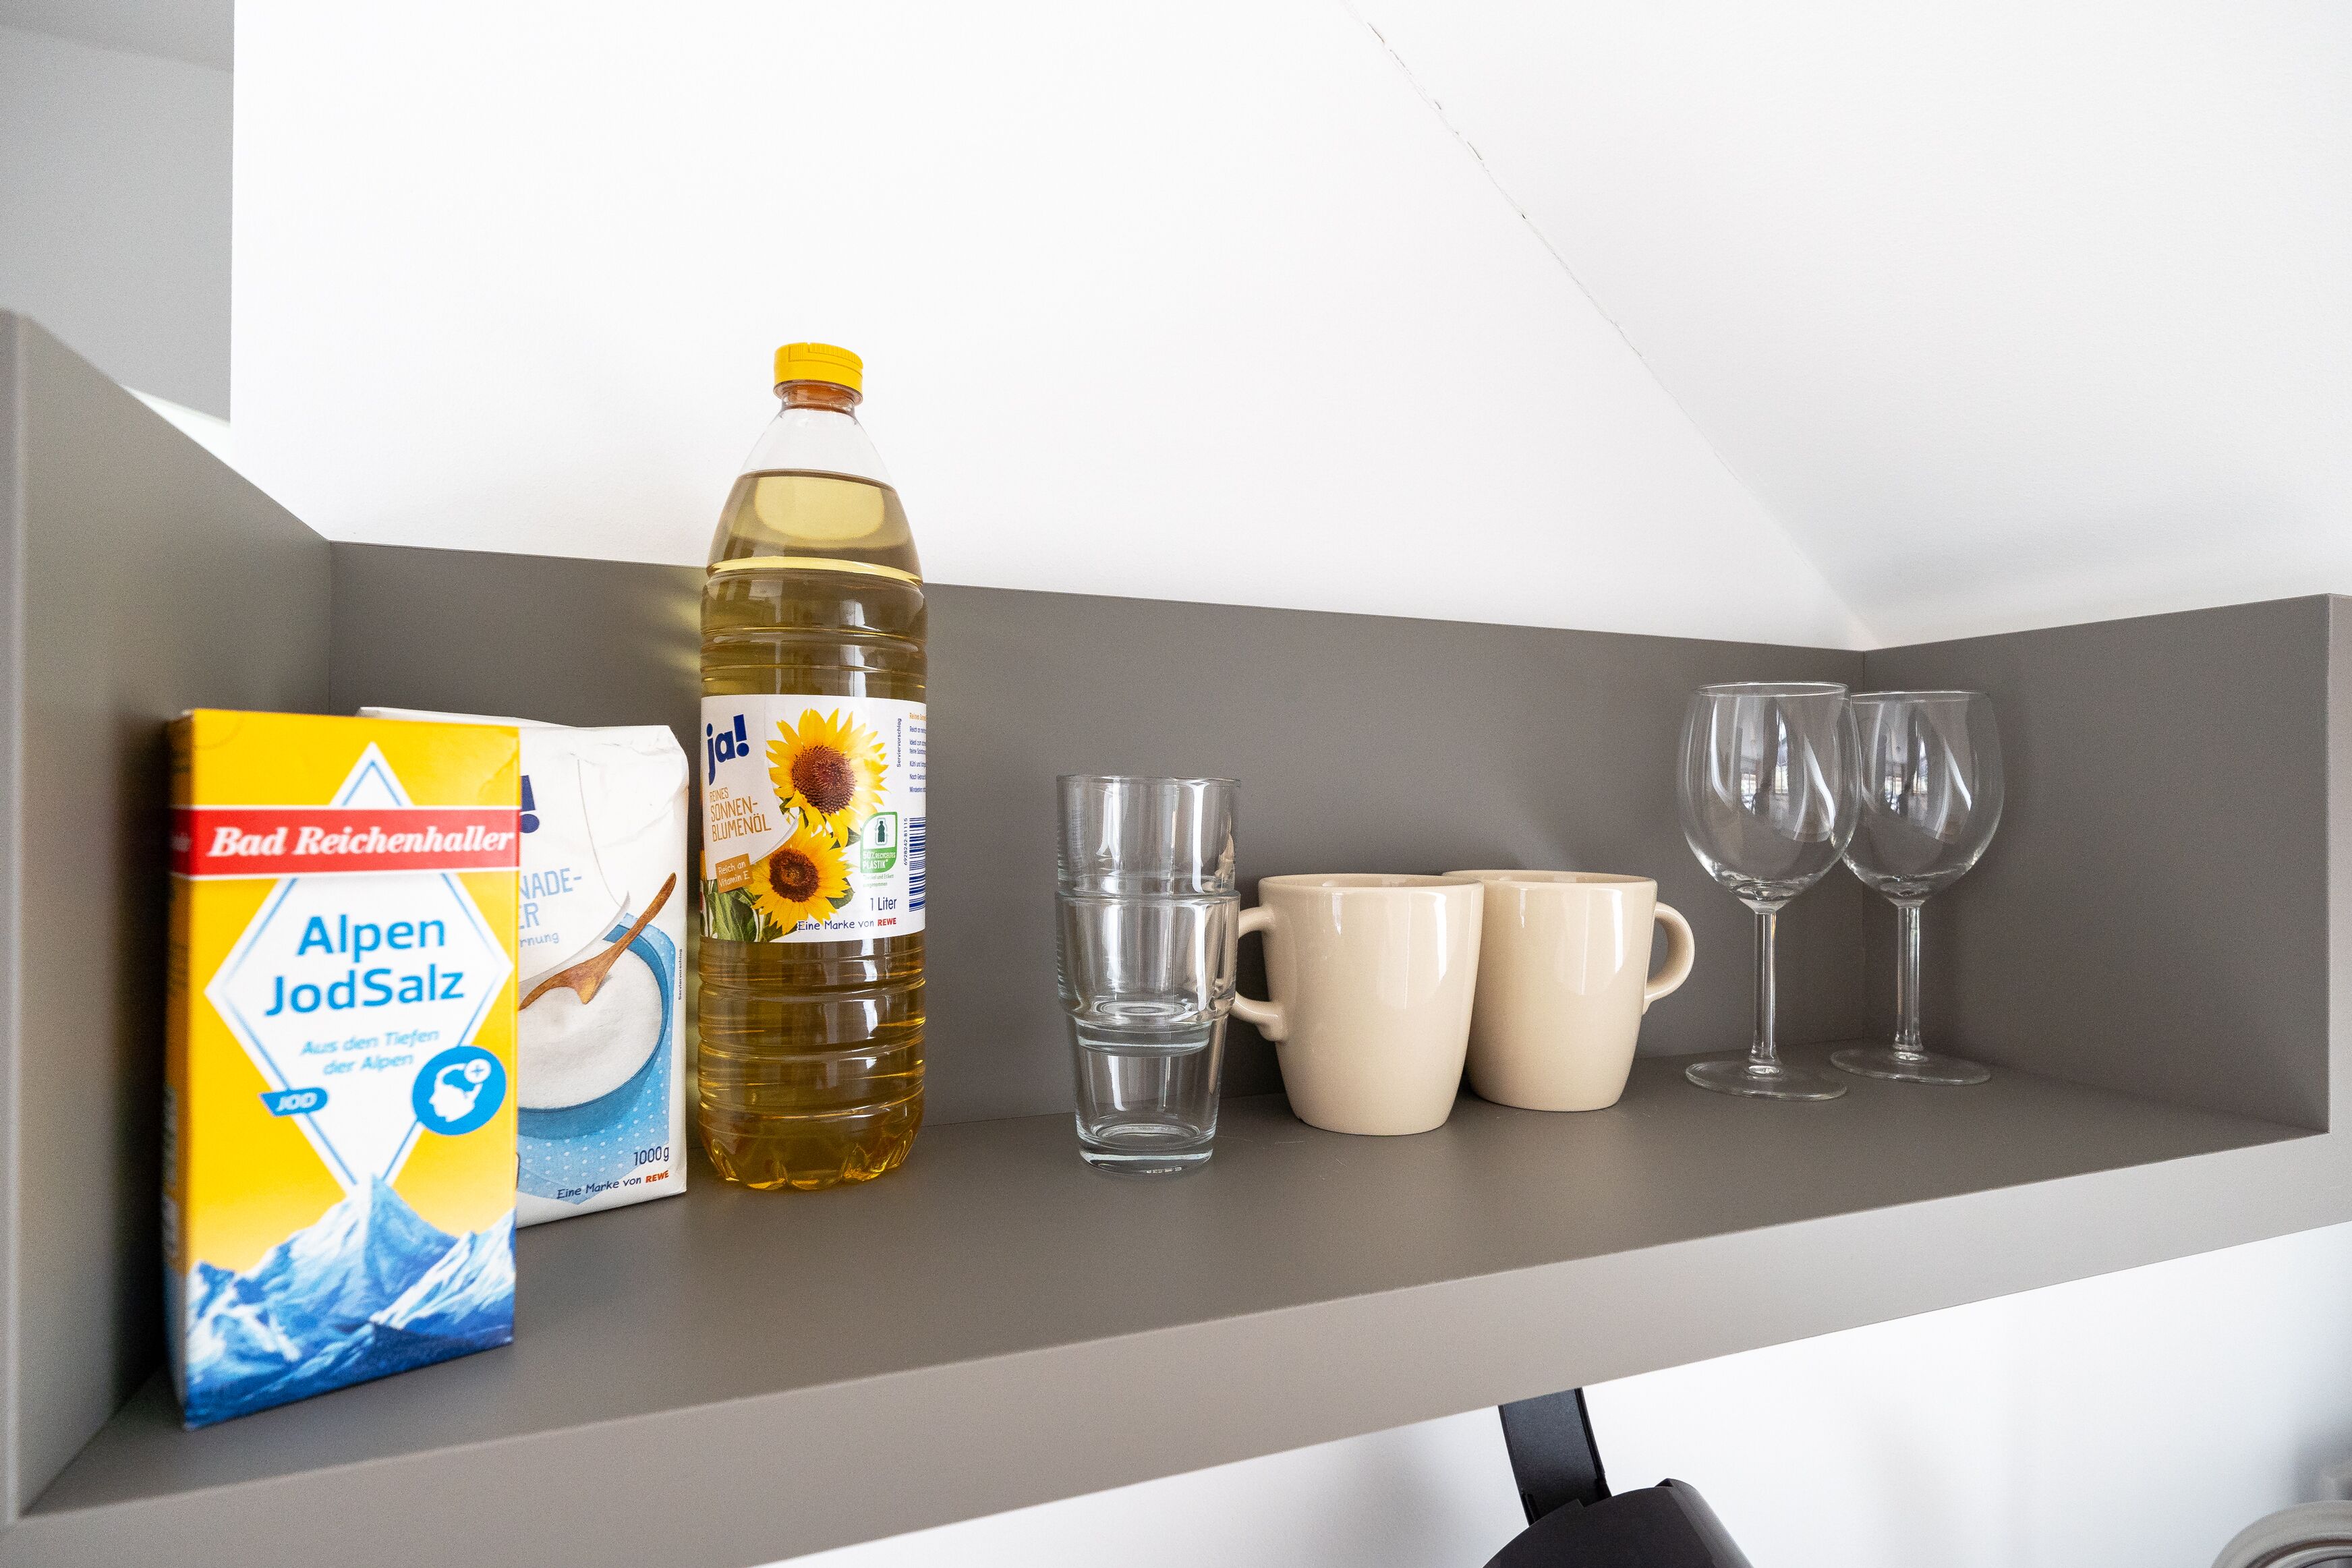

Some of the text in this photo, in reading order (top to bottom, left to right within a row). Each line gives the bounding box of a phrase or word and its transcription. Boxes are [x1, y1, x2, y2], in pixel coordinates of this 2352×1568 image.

[706, 714, 749, 786] ja!
[709, 786, 729, 803] REINES
[710, 795, 758, 823] SONNEN-
[712, 813, 772, 842] BLUMENÖL
[208, 826, 288, 858] Bad
[293, 825, 515, 855] Reichenhaller
[718, 861, 746, 876] Reich an
[718, 870, 750, 888] Vitamin E
[870, 896, 897, 911] 1 Liter
[798, 917, 897, 931] Eine Marke von REWE
[296, 914, 445, 964] Alpen
[264, 963, 465, 1017] JodSalz
[302, 1029, 440, 1055] Aus den Tiefen
[323, 1053, 414, 1075] der Alpen
[556, 1169, 669, 1199] Eine Marke von REWE
